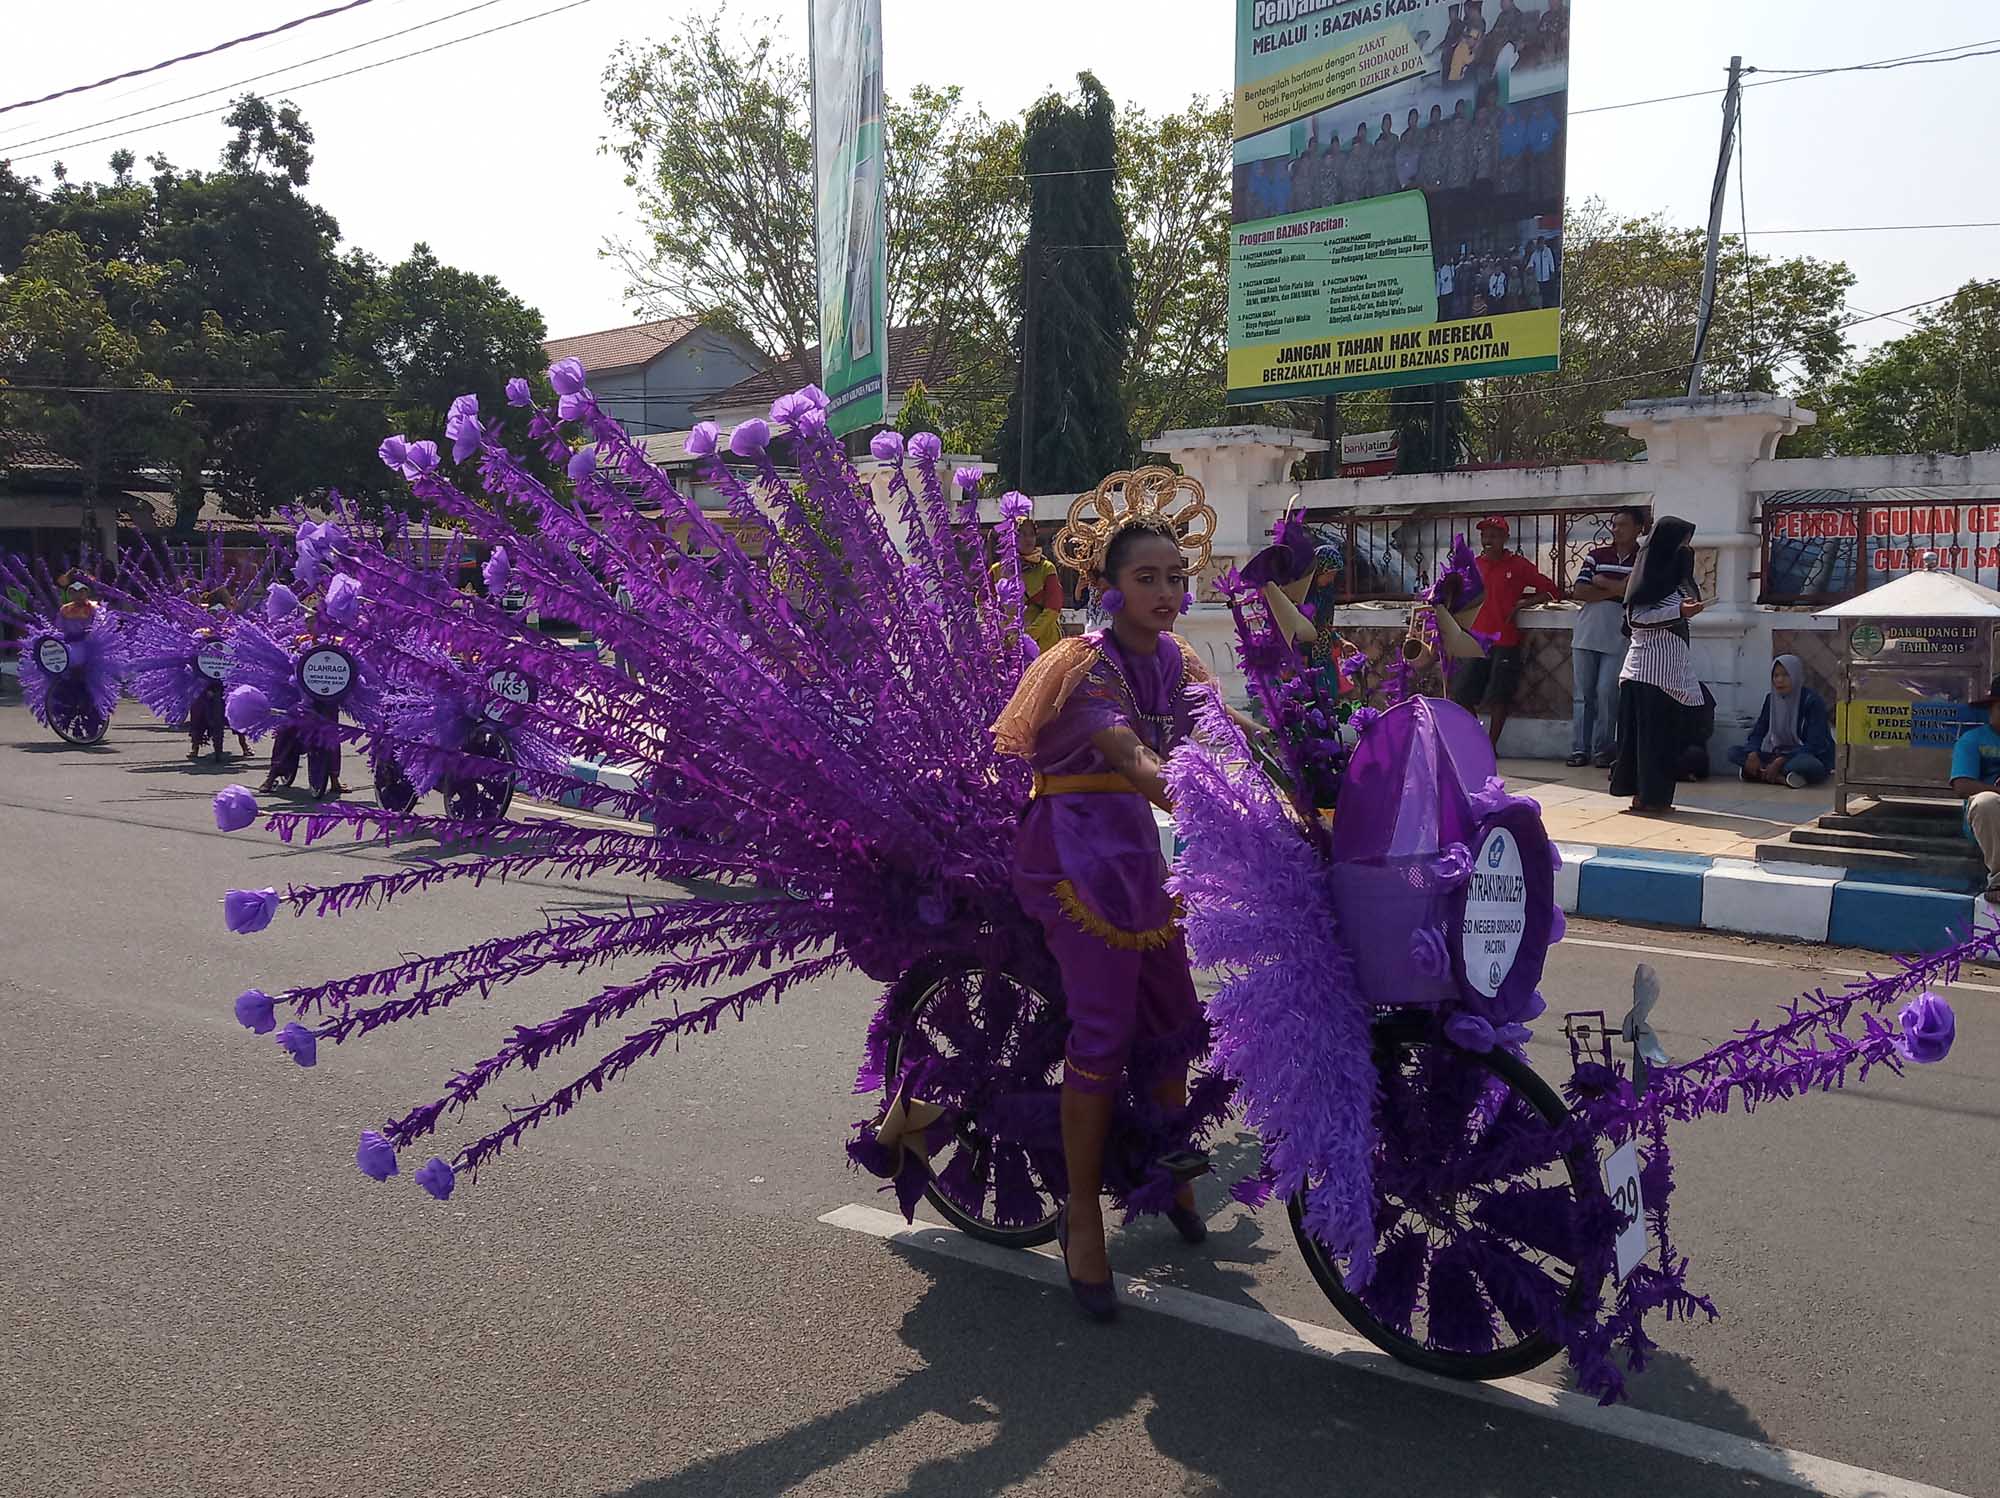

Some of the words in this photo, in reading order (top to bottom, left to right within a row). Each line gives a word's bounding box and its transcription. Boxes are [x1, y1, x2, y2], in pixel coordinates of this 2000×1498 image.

[1253, 24, 1307, 56] MELALUI
[1322, 5, 1382, 36] BAZNAS
[1244, 78, 1290, 102] Bentengilah
[1291, 64, 1323, 86] hartamu
[1325, 53, 1355, 71] dengan
[1358, 36, 1387, 56] ZAKAT
[1257, 95, 1280, 111] Obati
[1281, 79, 1324, 102] Penyakitmu
[1326, 67, 1356, 84] dengan
[1359, 43, 1409, 72] SHODAQOH
[1263, 105, 1291, 123] Hadapi
[1293, 92, 1325, 112] Ujianmu
[1327, 80, 1357, 98] dengan
[1360, 67, 1390, 88] DZIKIR
[1392, 65, 1399, 76] &
[1401, 55, 1423, 73] DO'A
[1239, 230, 1275, 247] Program
[1276, 222, 1309, 240] BAZNAS
[1310, 217, 1344, 234] Pacitan
[1276, 343, 1331, 364] JANGAN
[1337, 338, 1383, 357] TAHAN
[1390, 332, 1422, 350] HAK
[1428, 323, 1493, 347] MEREKA
[1263, 361, 1340, 383] BERZAKATLAH
[1344, 354, 1396, 374] MELALUI
[1400, 348, 1449, 367] BAZNAS
[1453, 342, 1509, 362] PACITAN
[1344, 440, 1388, 454] bankjatim
[1346, 466, 1365, 475] atm
[1890, 627, 1912, 638] DAK
[1916, 627, 1959, 638] BIDANG
[1962, 627, 1977, 638] LH
[1901, 642, 1938, 653] TAHUN
[1941, 643, 1965, 653] 2015
[308, 664, 346, 672] OLAHRAGA
[1867, 705, 1910, 716] TEMPAT
[1912, 707, 1957, 718] SAMPAH
[1463, 920, 1473, 934] SD
